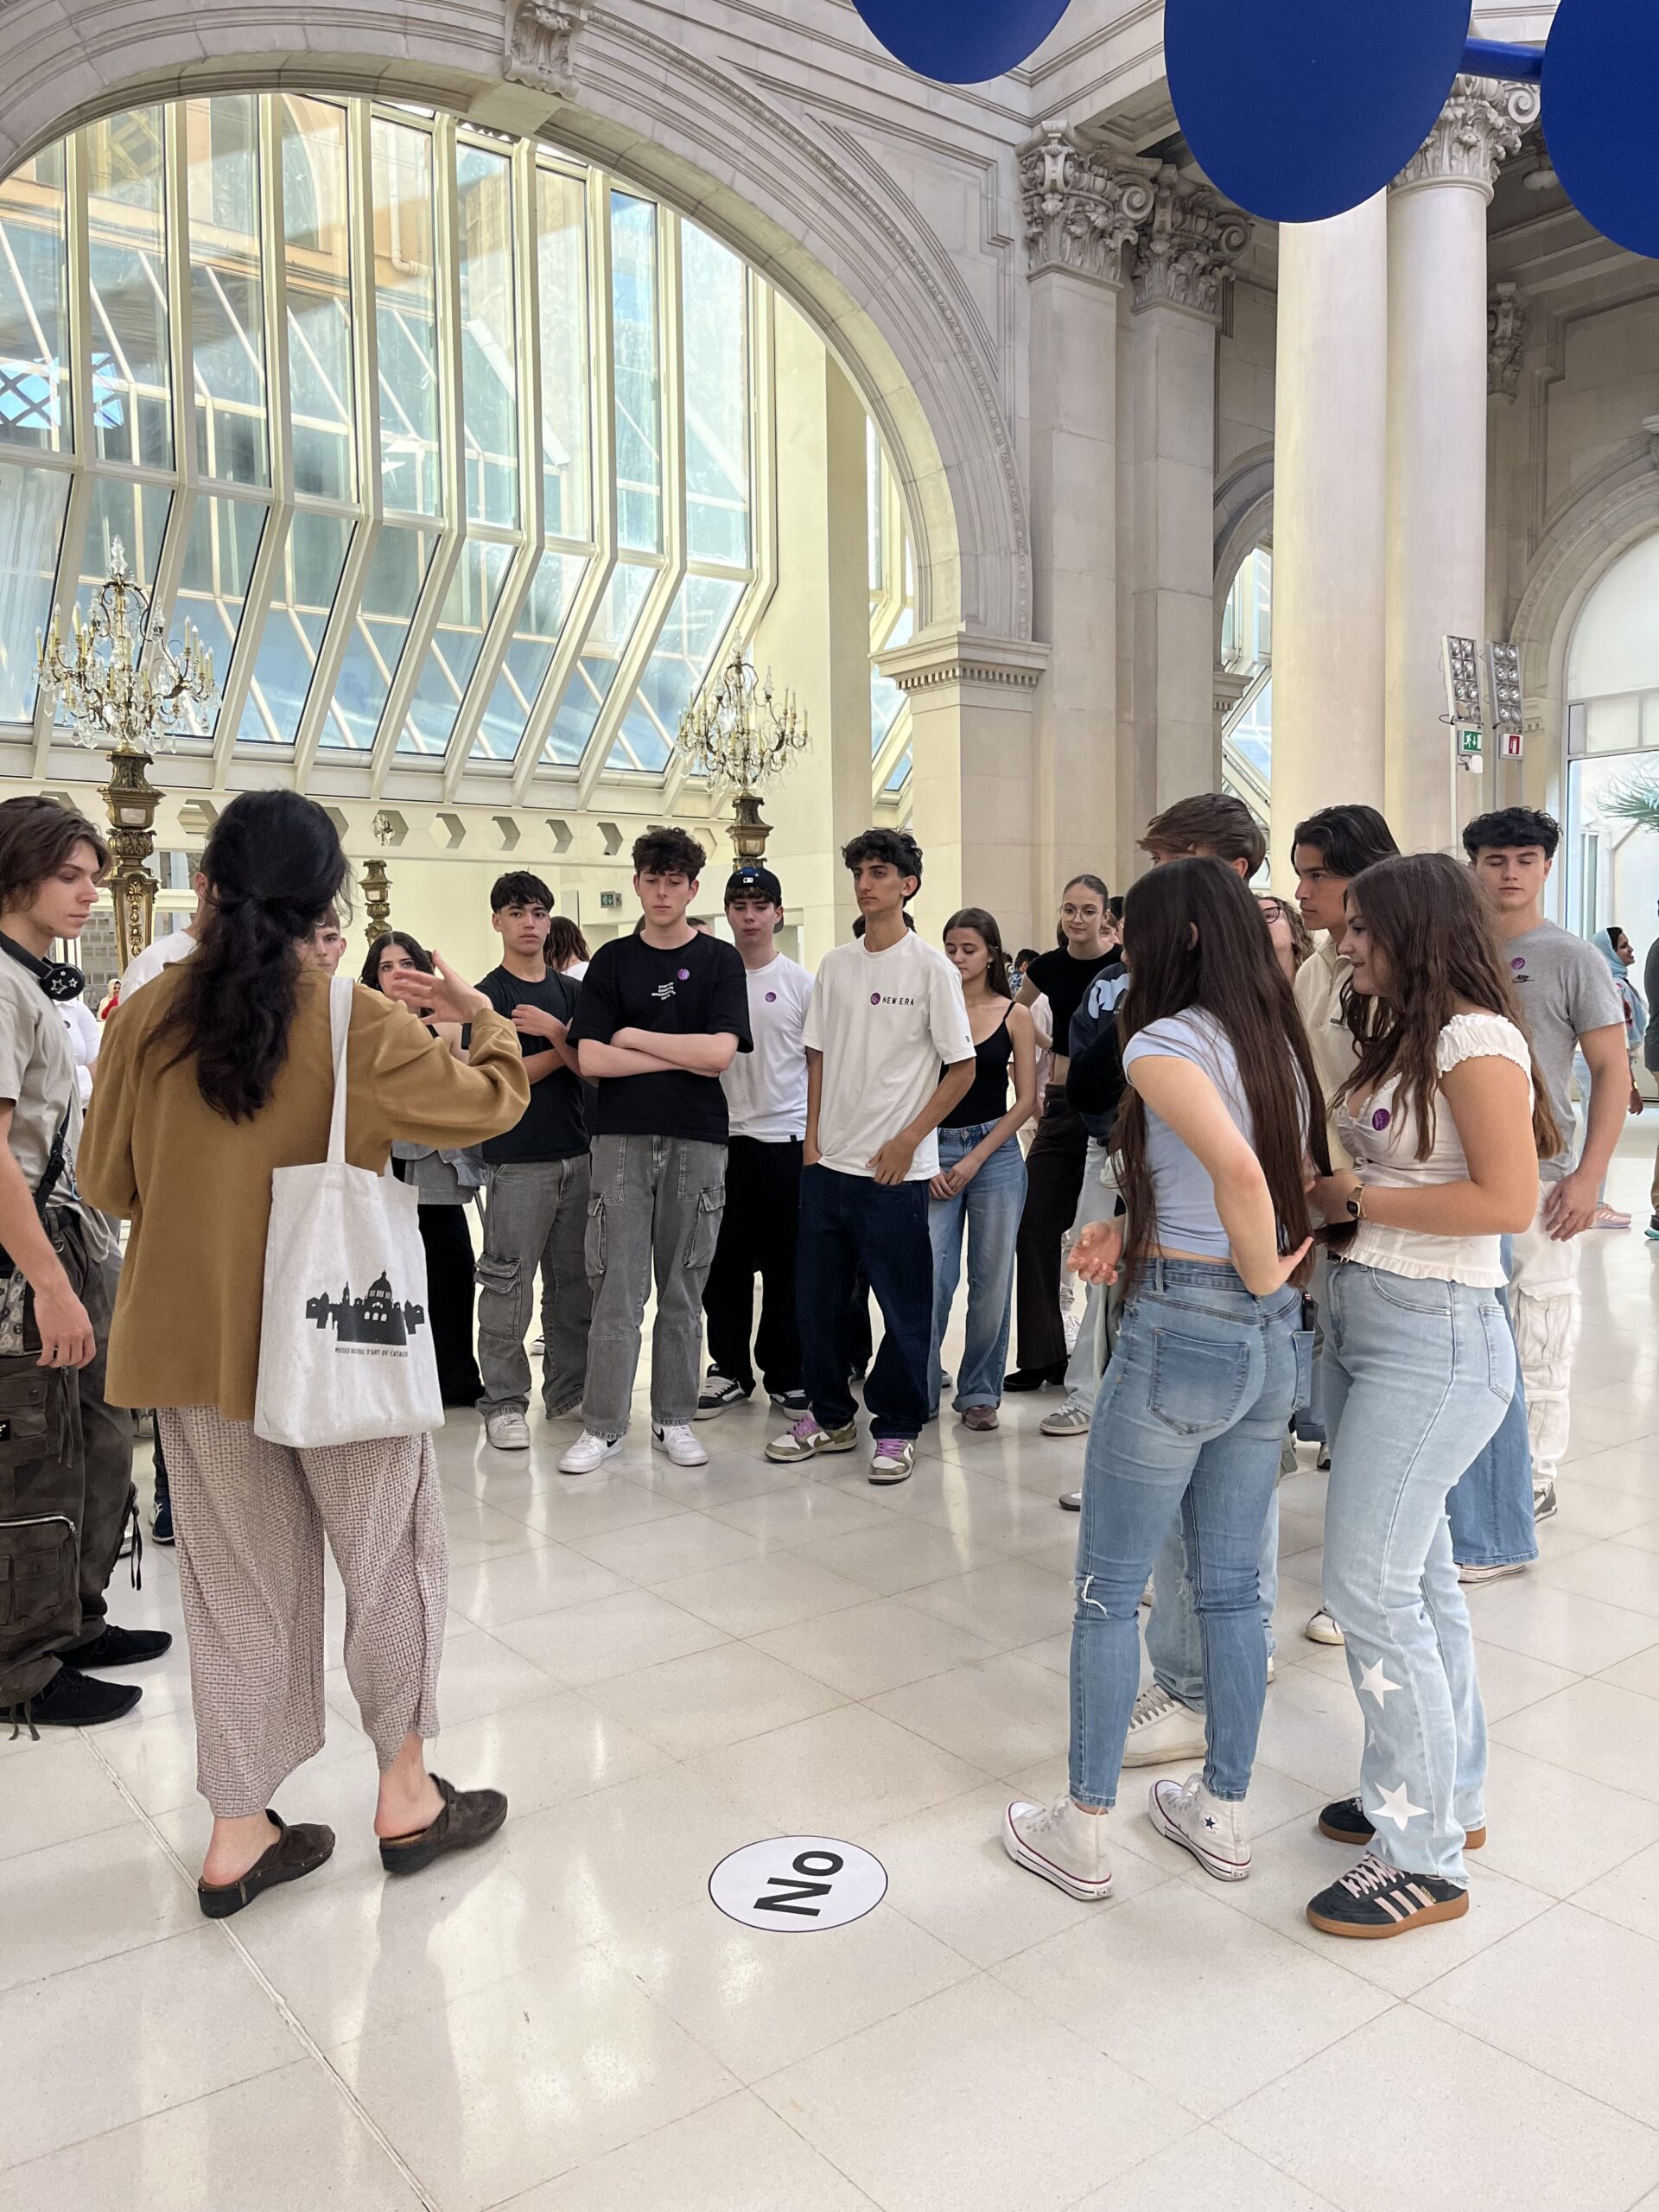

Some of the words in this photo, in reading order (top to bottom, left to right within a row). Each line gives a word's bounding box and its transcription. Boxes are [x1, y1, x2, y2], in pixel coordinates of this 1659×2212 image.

[882, 996, 897, 1005] NEW
[899, 997, 914, 1006] ERA
[753, 1850, 844, 1917] No
